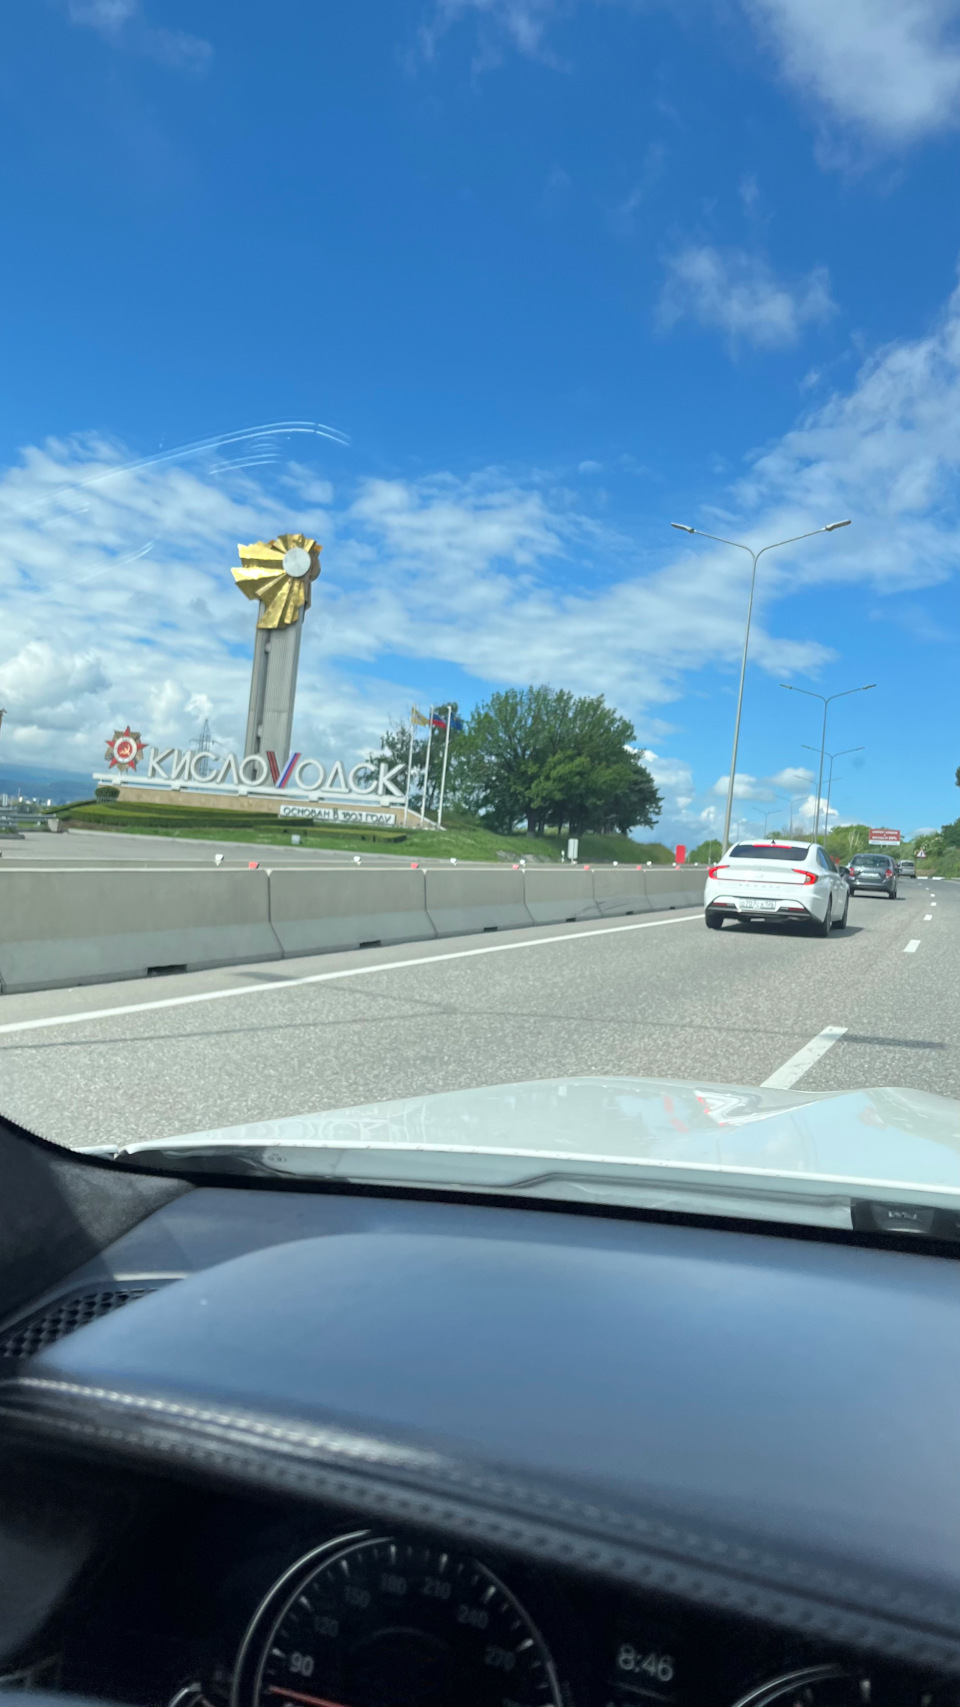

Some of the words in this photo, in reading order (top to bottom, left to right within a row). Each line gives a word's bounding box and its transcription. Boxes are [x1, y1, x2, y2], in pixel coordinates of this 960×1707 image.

[283, 806, 331, 819] ОСНОВАН
[341, 811, 363, 822] 1803
[365, 813, 392, 824] ГОДУ
[421, 1576, 452, 1600] 210
[289, 1650, 314, 1677] 90
[617, 1643, 674, 1682] 8:46
